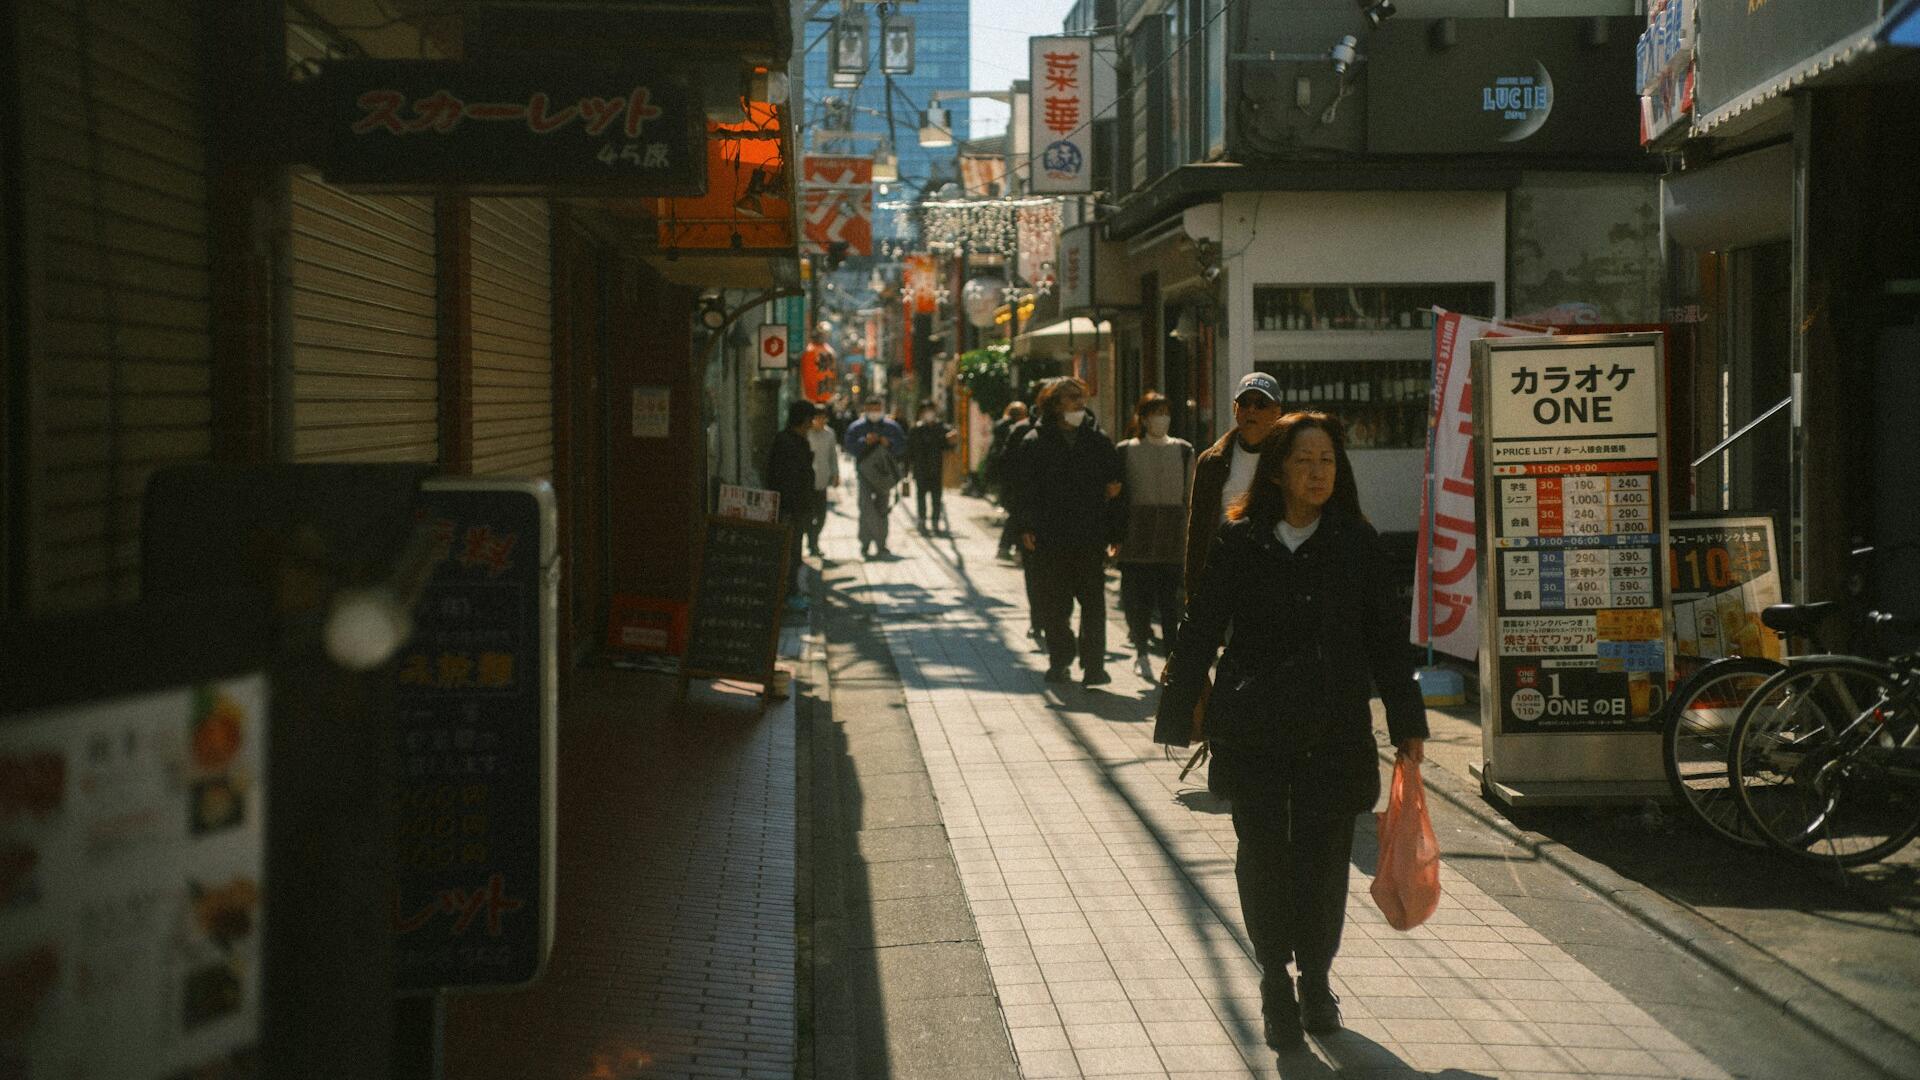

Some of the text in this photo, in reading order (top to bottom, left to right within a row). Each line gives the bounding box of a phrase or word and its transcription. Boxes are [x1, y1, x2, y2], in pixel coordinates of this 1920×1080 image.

[1483, 87, 1546, 111] LUCIE
[351, 85, 662, 138] スカーレット
[1511, 364, 1635, 395] カラオケ
[1533, 396, 1613, 424] ONE
[1503, 447, 1531, 456] PRICE
[1533, 447, 1554, 455] LIST
[1510, 483, 1527, 491] 学生
[1507, 495, 1532, 504] シニア
[1511, 518, 1530, 527] 会員
[1513, 555, 1530, 563] 学生
[1510, 568, 1535, 576] シニア
[1513, 591, 1532, 600] 会員
[1504, 634, 1596, 645] 焼き立てワッフル
[1547, 698, 1626, 716] ONE の日
